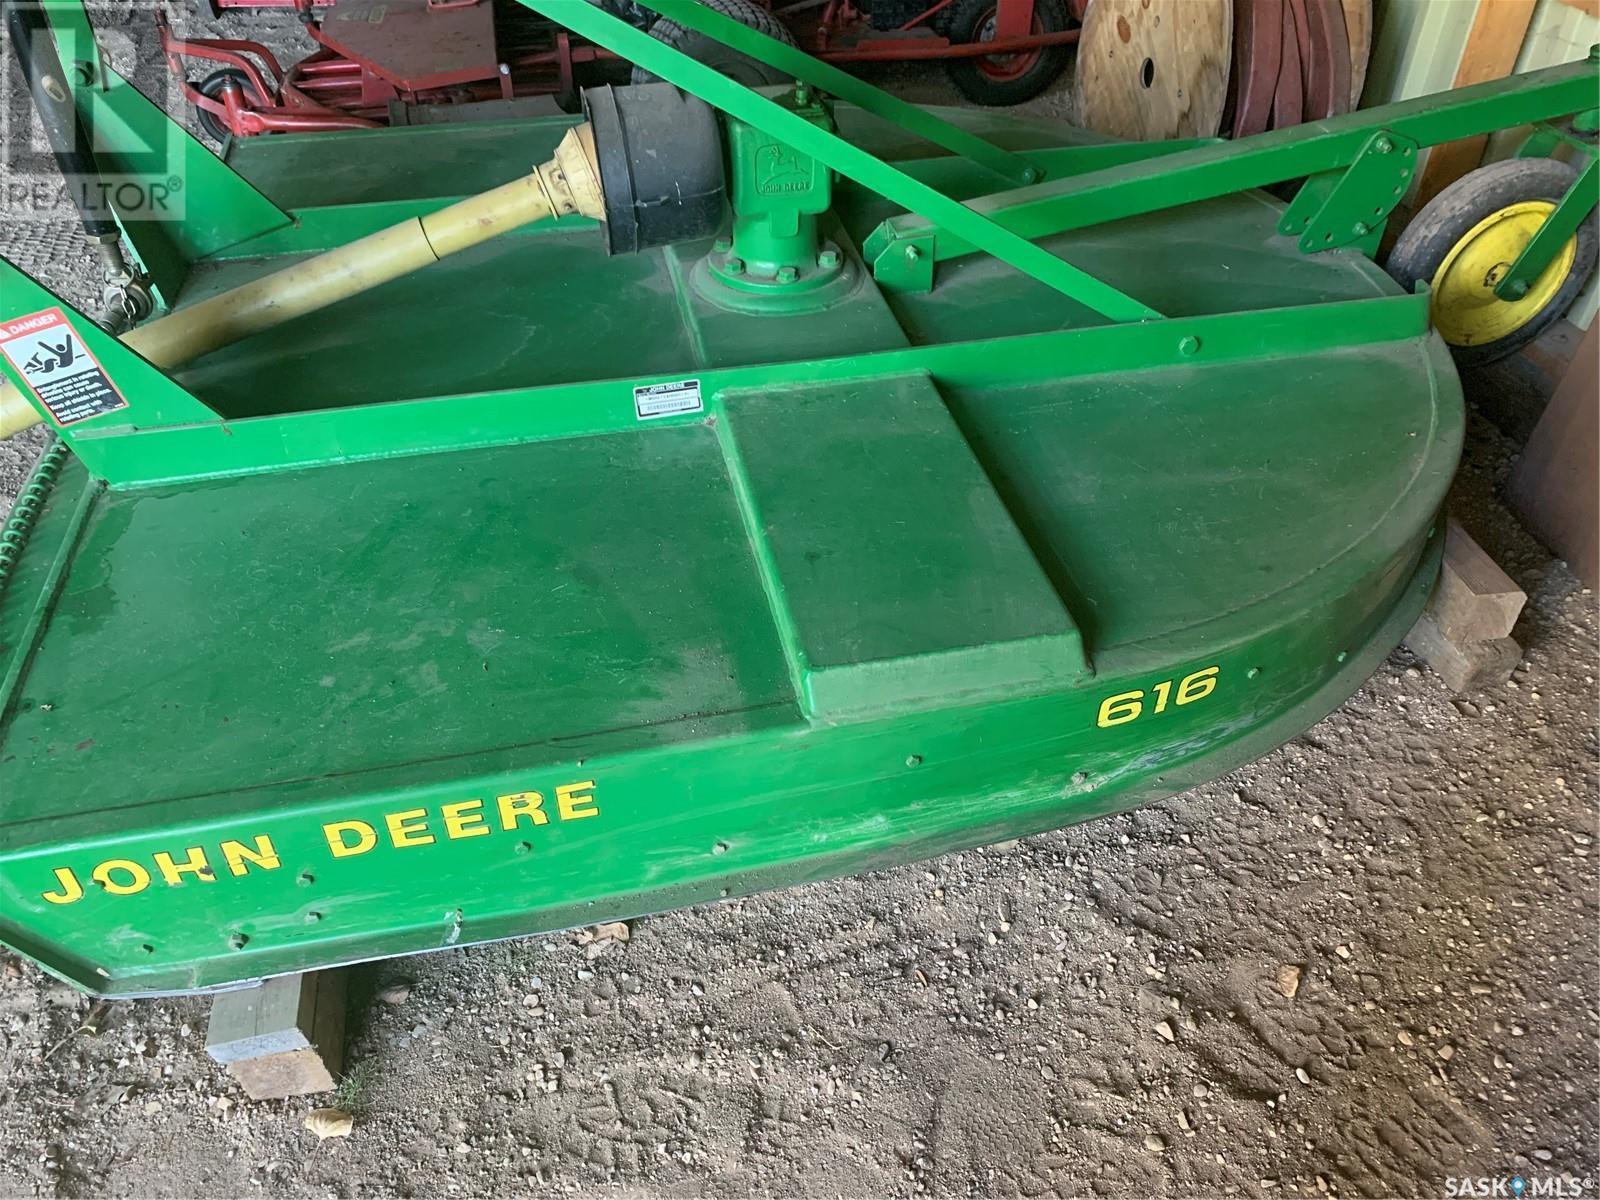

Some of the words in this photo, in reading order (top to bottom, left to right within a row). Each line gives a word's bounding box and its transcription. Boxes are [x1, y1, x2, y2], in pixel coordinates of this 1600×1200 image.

[8, 313, 58, 335] DANGER
[1096, 665, 1220, 729] 616
[42, 834, 283, 906] JOHN
[321, 779, 600, 859] DEERE
